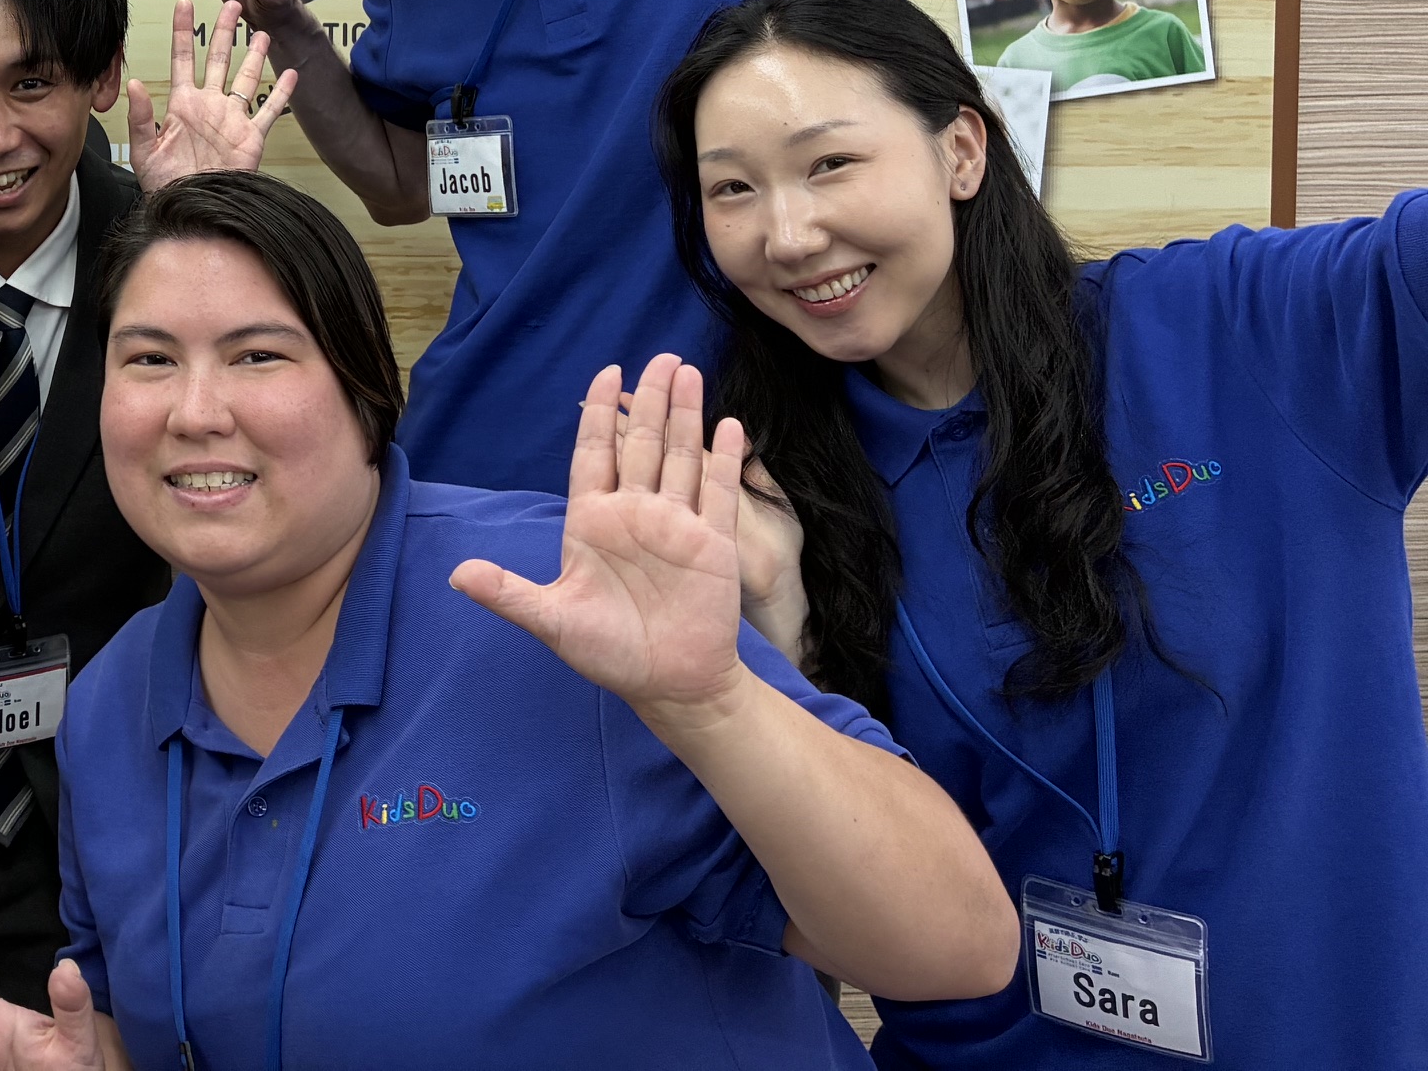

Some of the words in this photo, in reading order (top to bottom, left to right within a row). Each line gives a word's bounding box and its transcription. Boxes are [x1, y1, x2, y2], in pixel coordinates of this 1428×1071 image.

[439, 165, 492, 195] Jacob
[1123, 460, 1222, 511] idsDuo
[359, 784, 477, 830] KidsDuo
[1072, 971, 1160, 1028] Sara
